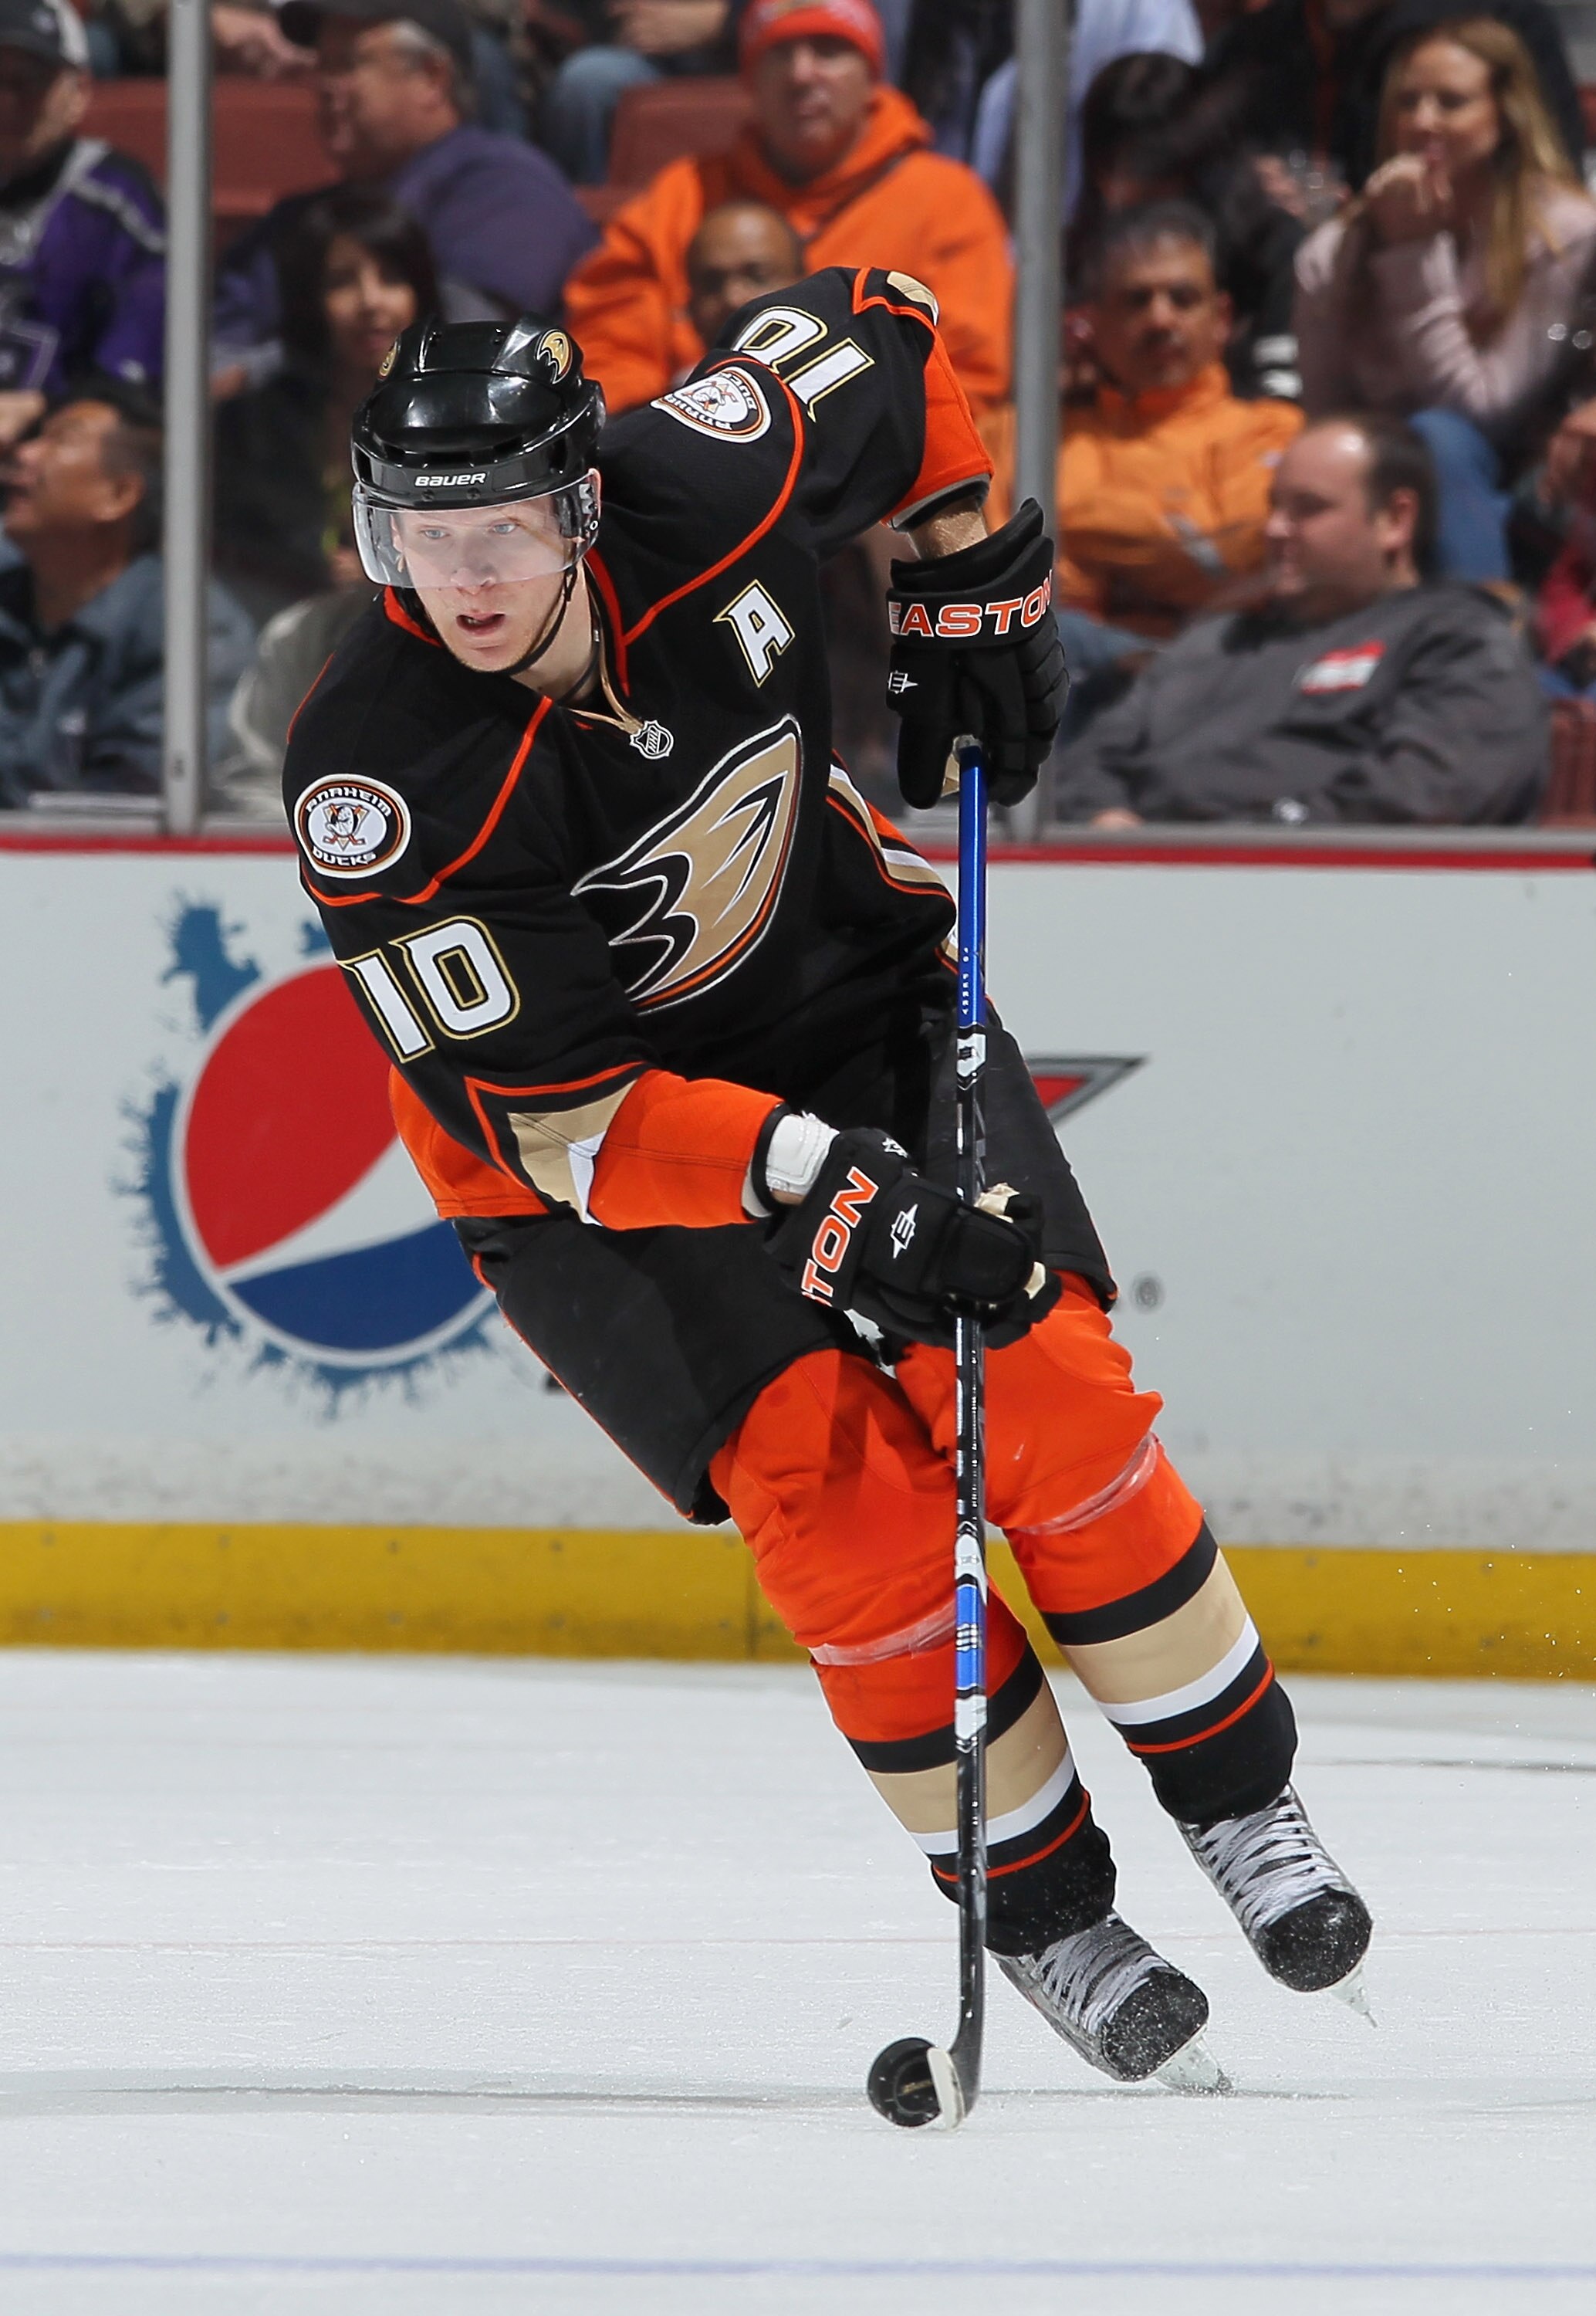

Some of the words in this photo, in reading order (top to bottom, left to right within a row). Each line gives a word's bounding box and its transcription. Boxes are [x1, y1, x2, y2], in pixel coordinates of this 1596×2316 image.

[414, 472, 486, 487] BAUER
[712, 579, 796, 688] A
[888, 569, 1053, 638] EASTON
[306, 787, 392, 818] ANAHEIM
[312, 846, 377, 866] DUCKS
[336, 915, 521, 1065] 10
[801, 1166, 880, 1307] TON
